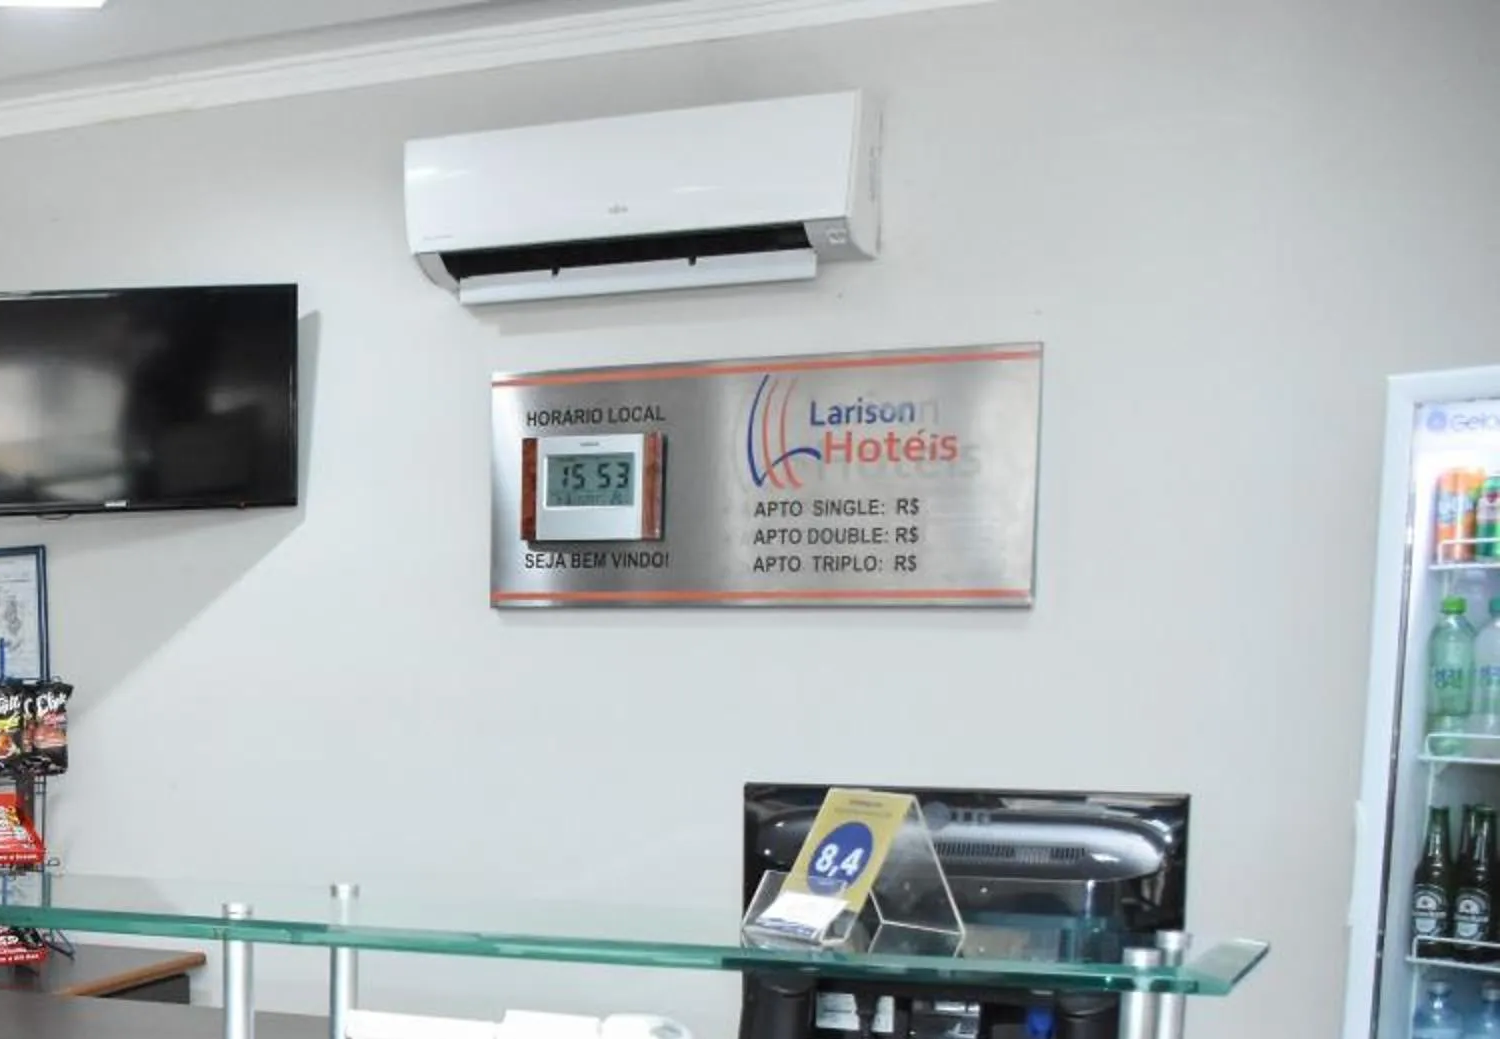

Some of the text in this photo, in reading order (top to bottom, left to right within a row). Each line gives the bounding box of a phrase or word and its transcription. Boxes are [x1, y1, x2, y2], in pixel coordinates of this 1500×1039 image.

[608, 405, 666, 424] LOCAL
[810, 397, 915, 426] Larison
[823, 429, 958, 465] Hotéis
[754, 498, 920, 517] APTO SINGLE: R$
[753, 526, 919, 545] APTO DOUBLE: R$
[525, 551, 669, 569] SEJA BEM VINDO!
[753, 555, 918, 573] APTO TRIPLO: R$
[815, 843, 863, 877] 8,4
